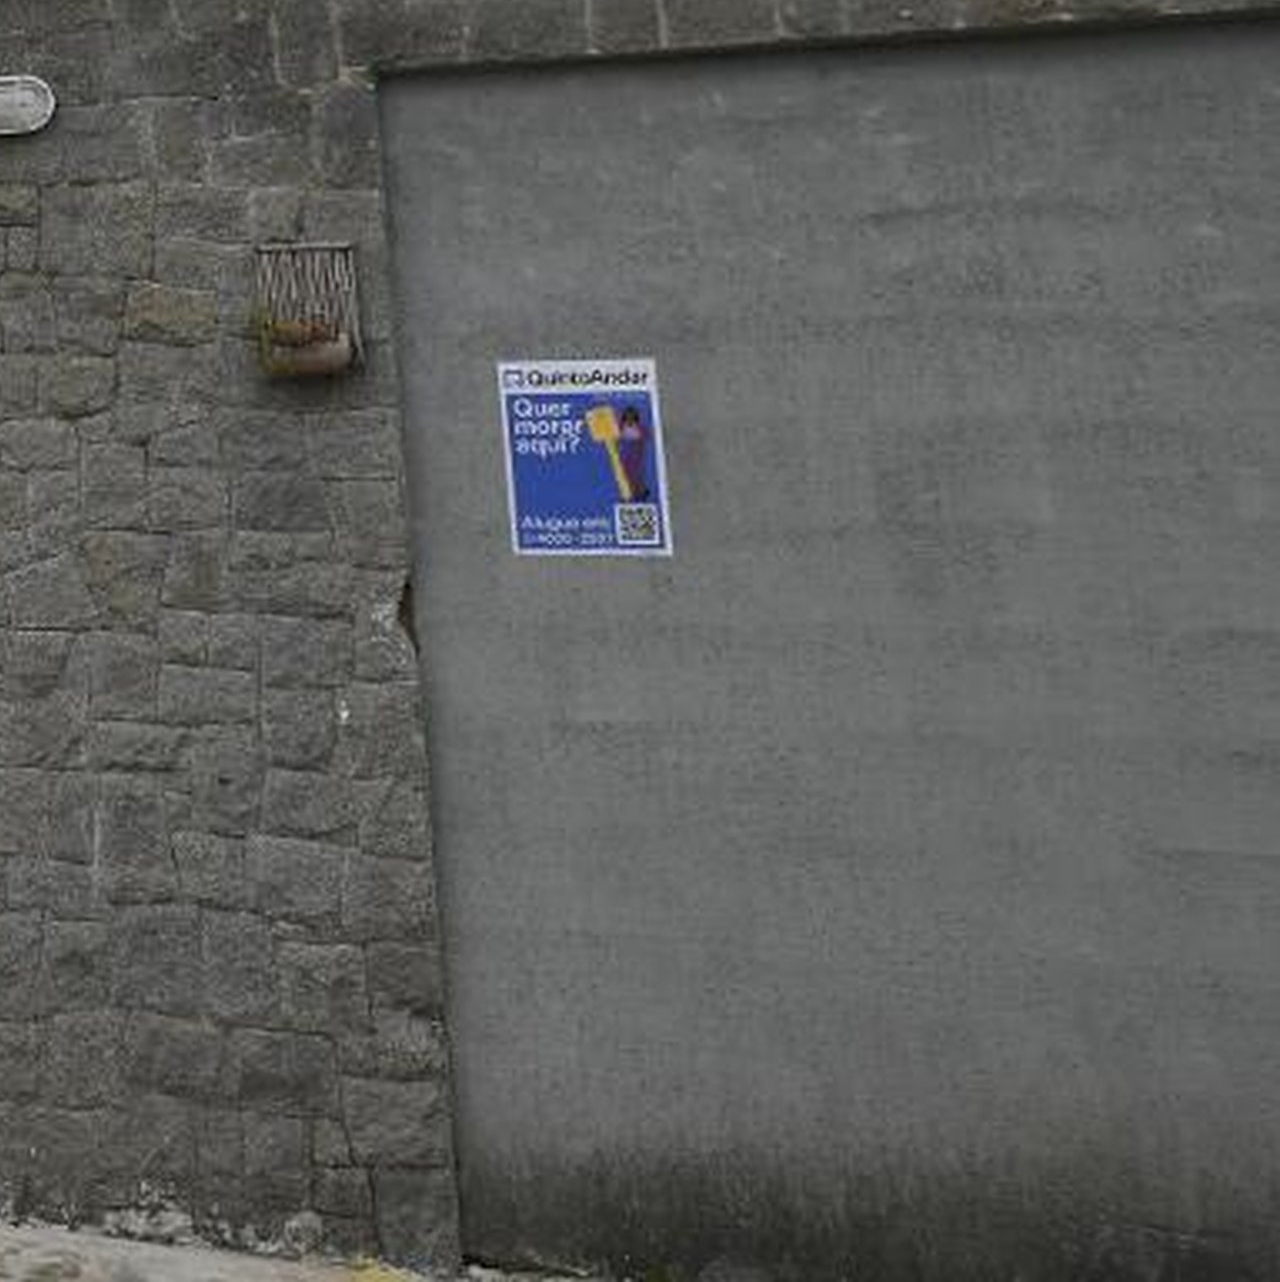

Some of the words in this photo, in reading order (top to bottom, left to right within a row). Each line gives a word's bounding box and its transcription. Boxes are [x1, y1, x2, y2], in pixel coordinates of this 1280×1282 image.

[528, 369, 648, 386] QuintoAndar
[513, 398, 571, 417] Quer
[514, 419, 583, 435] morar
[515, 435, 582, 459] aqui?
